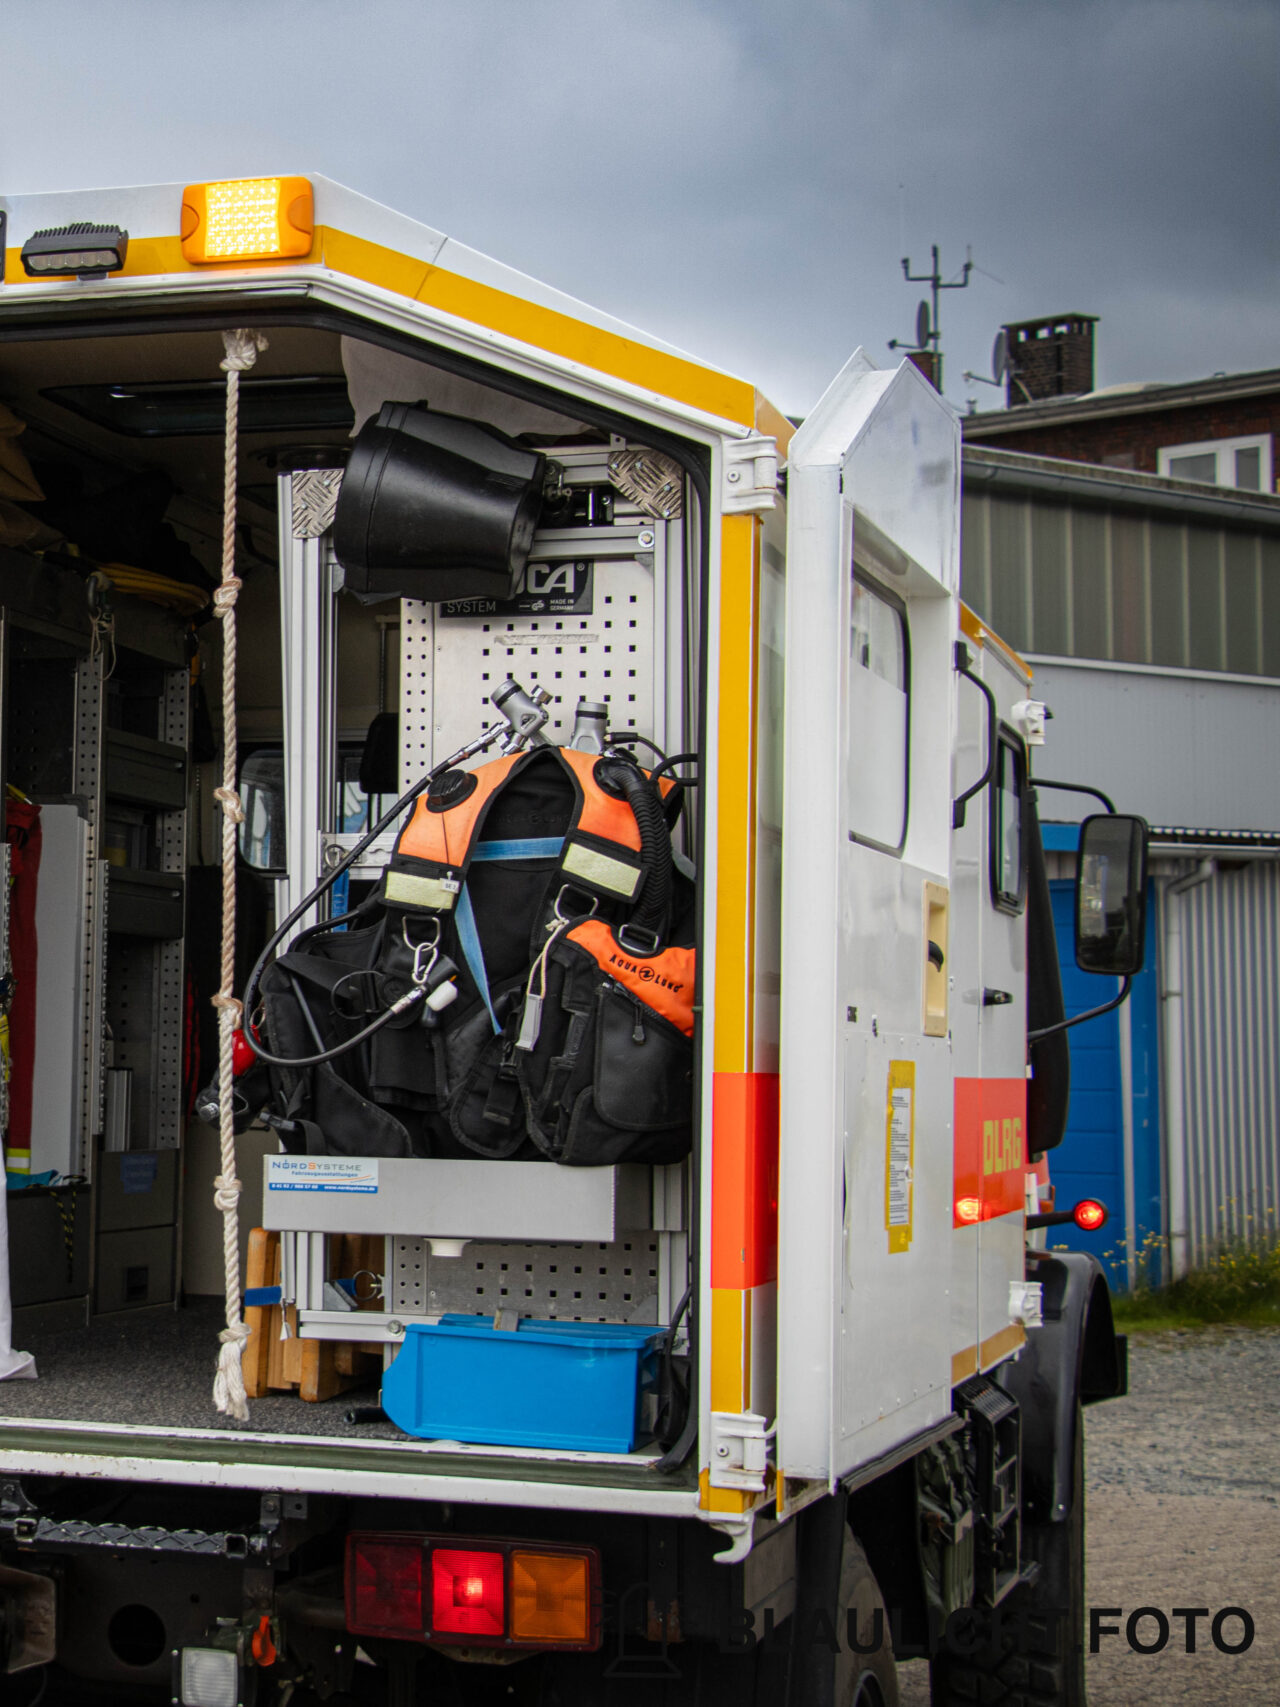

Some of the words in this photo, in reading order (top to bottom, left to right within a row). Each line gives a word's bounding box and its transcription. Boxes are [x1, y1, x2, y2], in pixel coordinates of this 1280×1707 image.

[447, 601, 496, 613] SYSTEM
[609, 954, 638, 974] AQUA
[655, 975, 679, 993] LUNG
[983, 1117, 1022, 1176] DLRG
